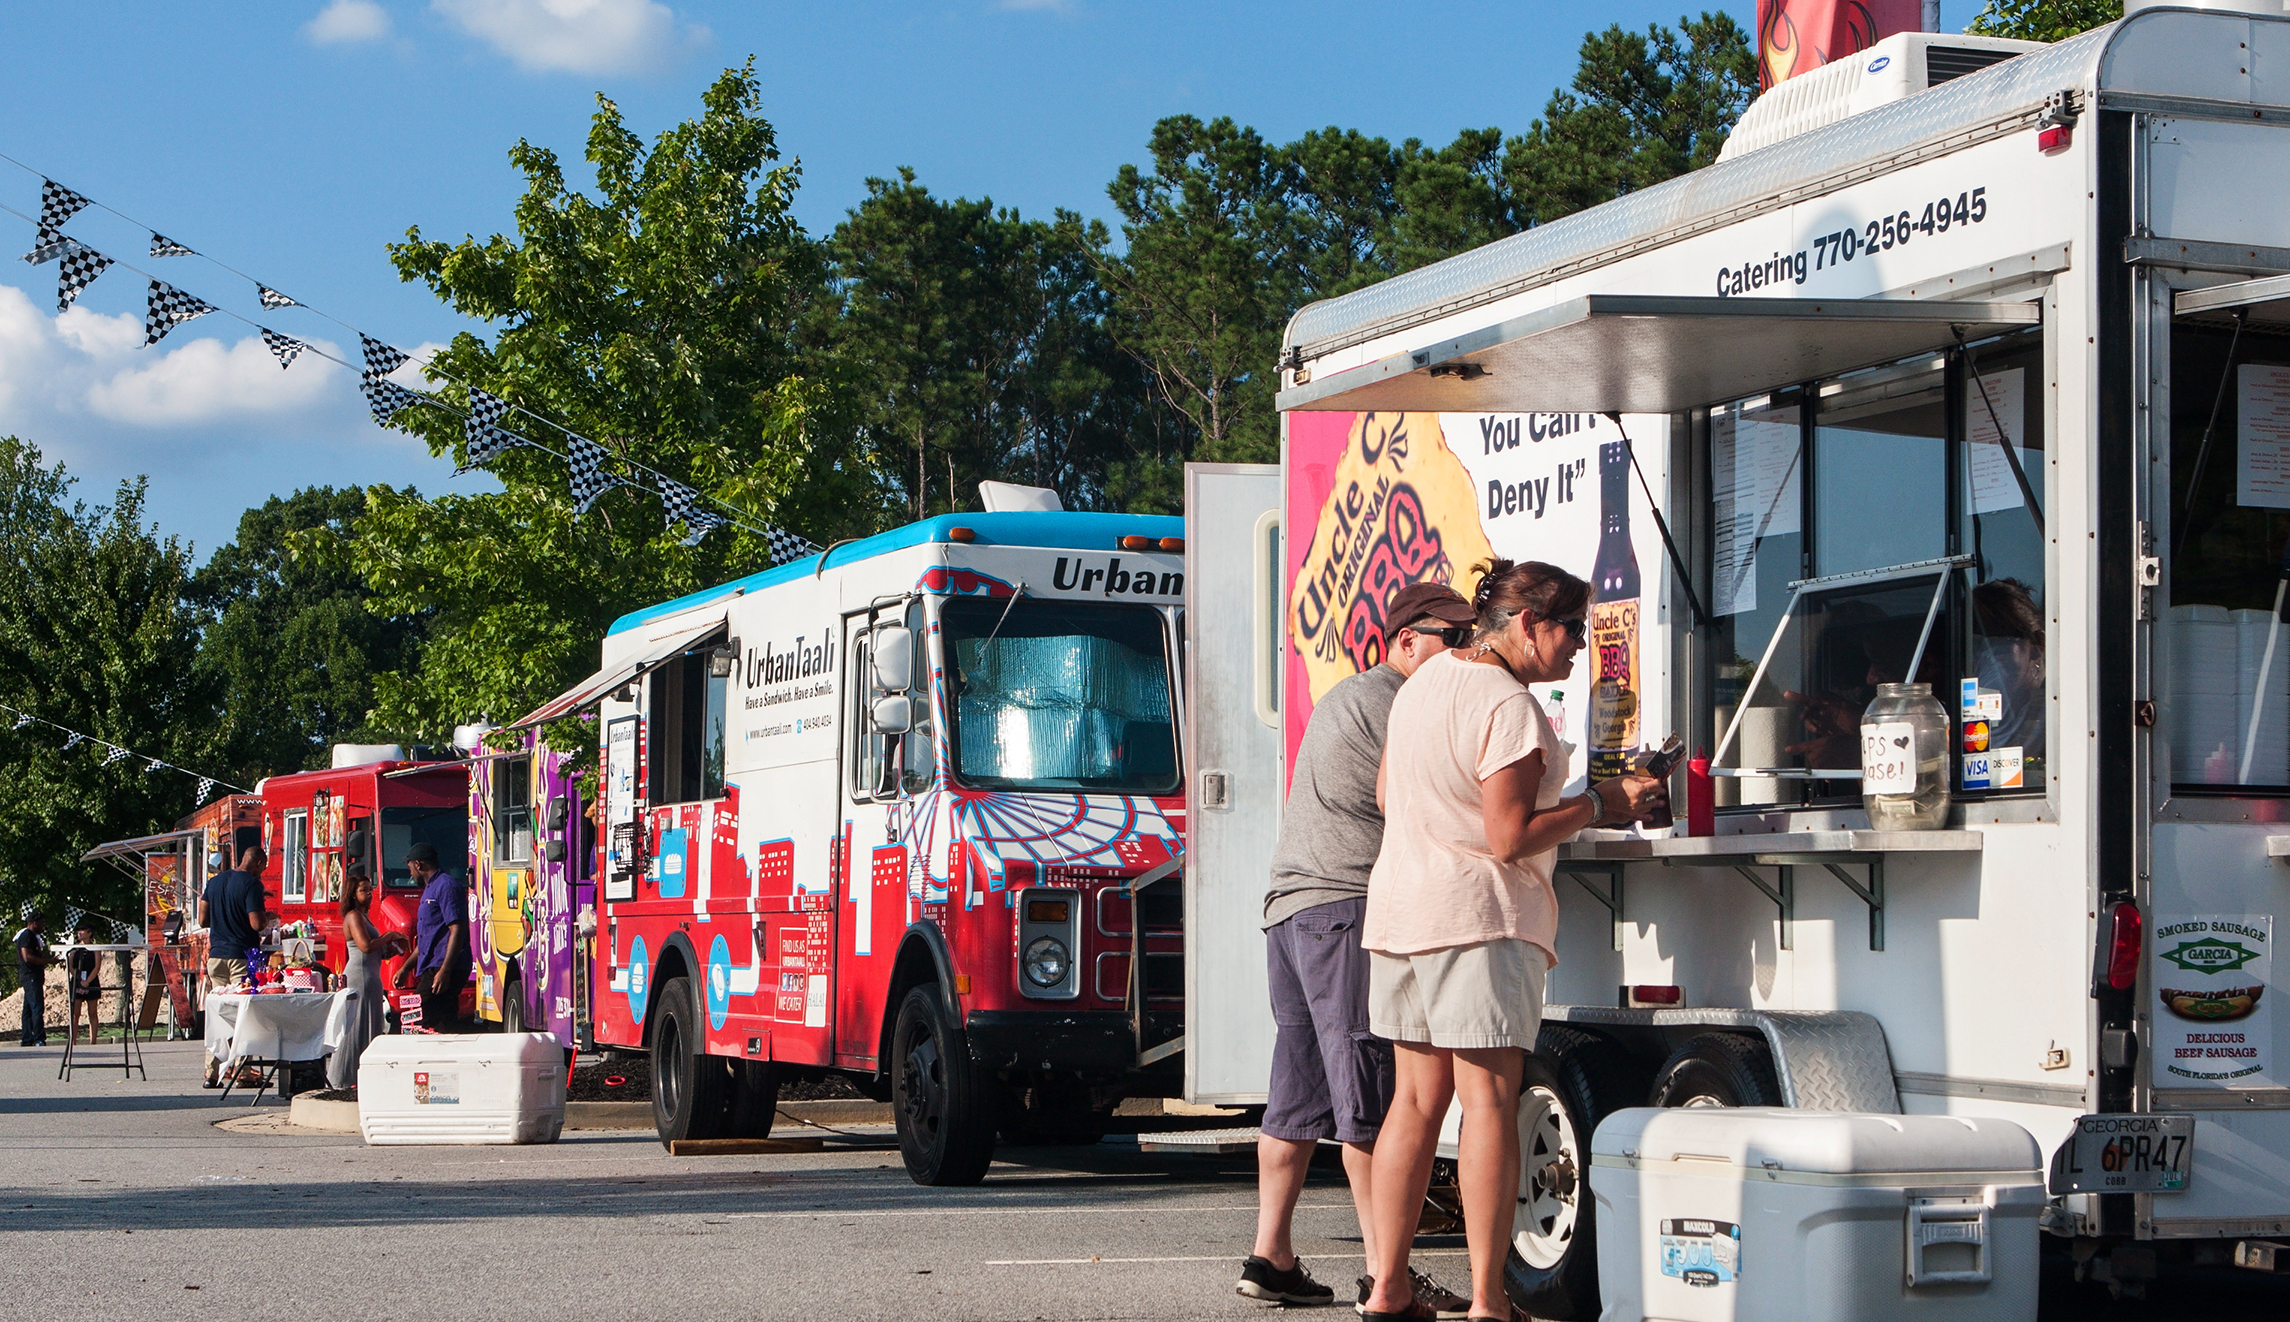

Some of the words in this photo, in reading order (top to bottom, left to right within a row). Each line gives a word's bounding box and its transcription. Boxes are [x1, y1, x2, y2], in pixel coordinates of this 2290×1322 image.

[1716, 251, 1807, 298] Catering
[1813, 186, 1987, 271] 770-256-4945
[1479, 414, 1520, 456] You
[1529, 413, 1596, 443] Cant
[1488, 476, 1550, 520] Deny
[1338, 473, 1390, 609] ORIGINAL
[1297, 480, 1364, 640] Uncle
[1053, 557, 1185, 596] Urban
[1593, 611, 1620, 631] Uncle
[746, 627, 835, 690] UrbanTaali
[1599, 640, 1631, 685] BBQ
[745, 696, 759, 710] Have
[759, 696, 763, 708] a
[763, 686, 793, 707] Sandwich.
[793, 686, 809, 701] Have
[809, 686, 813, 698] a
[814, 679, 834, 697] Smile.
[1599, 705, 1632, 718] Woodstock
[1966, 760, 1989, 776] VISA
[1993, 757, 2020, 769] DISCOVER
[2157, 921, 2208, 940] SMOKED
[2211, 921, 2266, 943] SAUSAGE
[782, 939, 792, 953] FIND
[792, 939, 799, 953] US
[799, 939, 805, 953] AS
[2188, 949, 2233, 960] GARCIA
[778, 996, 786, 1011] WE
[786, 997, 802, 1011] CATER
[2186, 1033, 2246, 1044] DELICIOUS
[2174, 1048, 2204, 1058] BEEF
[2206, 1047, 2258, 1058] SAUSAGE
[2167, 1064, 2192, 1079] SOUTH
[2192, 1070, 2230, 1080] FLORIDA'S
[2230, 1064, 2264, 1079] ORIGINAL
[2083, 1119, 2159, 1134] GEORGIA
[2101, 1135, 2188, 1172] 6PR47
[2105, 1176, 2127, 1186] COBB
[2164, 1172, 2178, 1181] JUL
[1682, 1220, 1716, 1234] MAXCOLD
